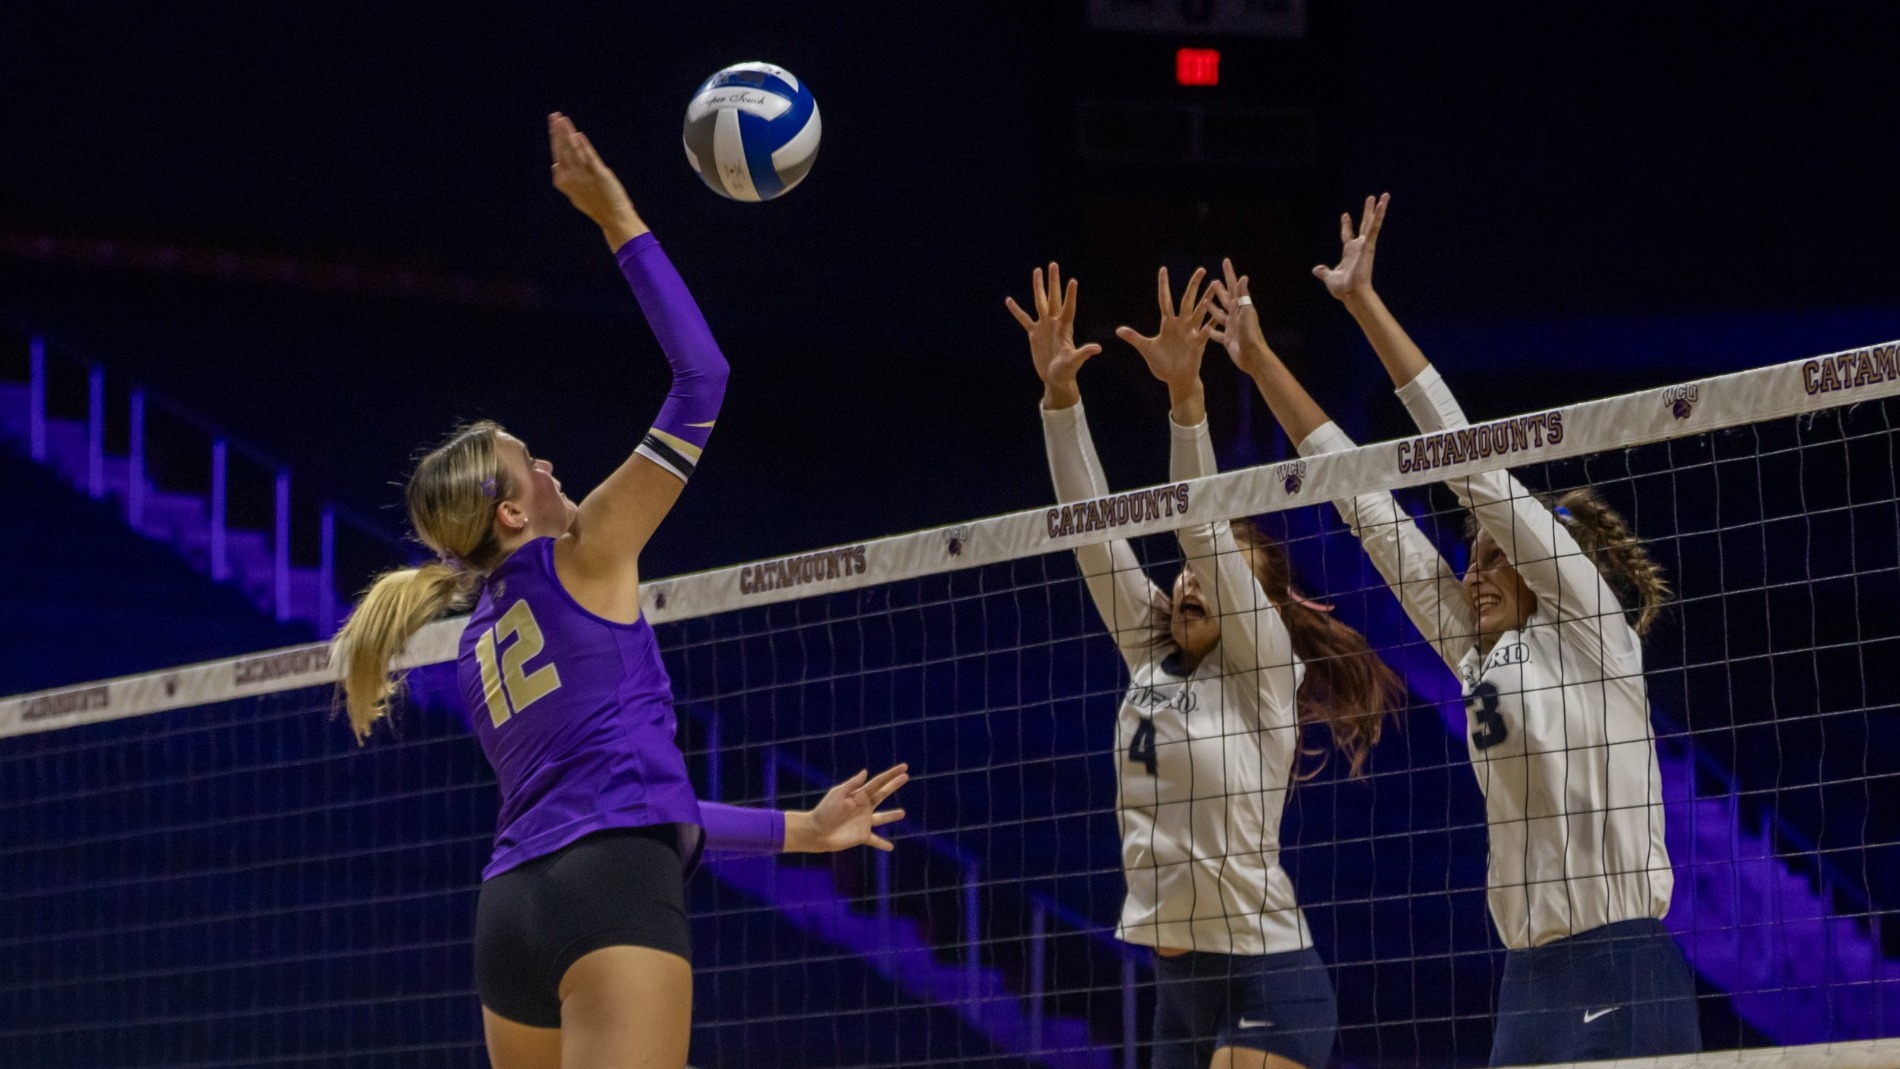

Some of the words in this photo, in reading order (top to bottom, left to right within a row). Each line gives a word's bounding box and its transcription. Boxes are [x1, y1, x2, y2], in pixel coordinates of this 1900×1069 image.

[1803, 344, 1900, 396] CATAM
[1398, 411, 1564, 474] CATAMOUNTS
[1047, 483, 1190, 538] CATAMOUNTS
[740, 545, 867, 594] CATAMOUNTS
[475, 598, 562, 730] 12
[1464, 682, 1508, 750] 3
[1129, 718, 1158, 775] 4
